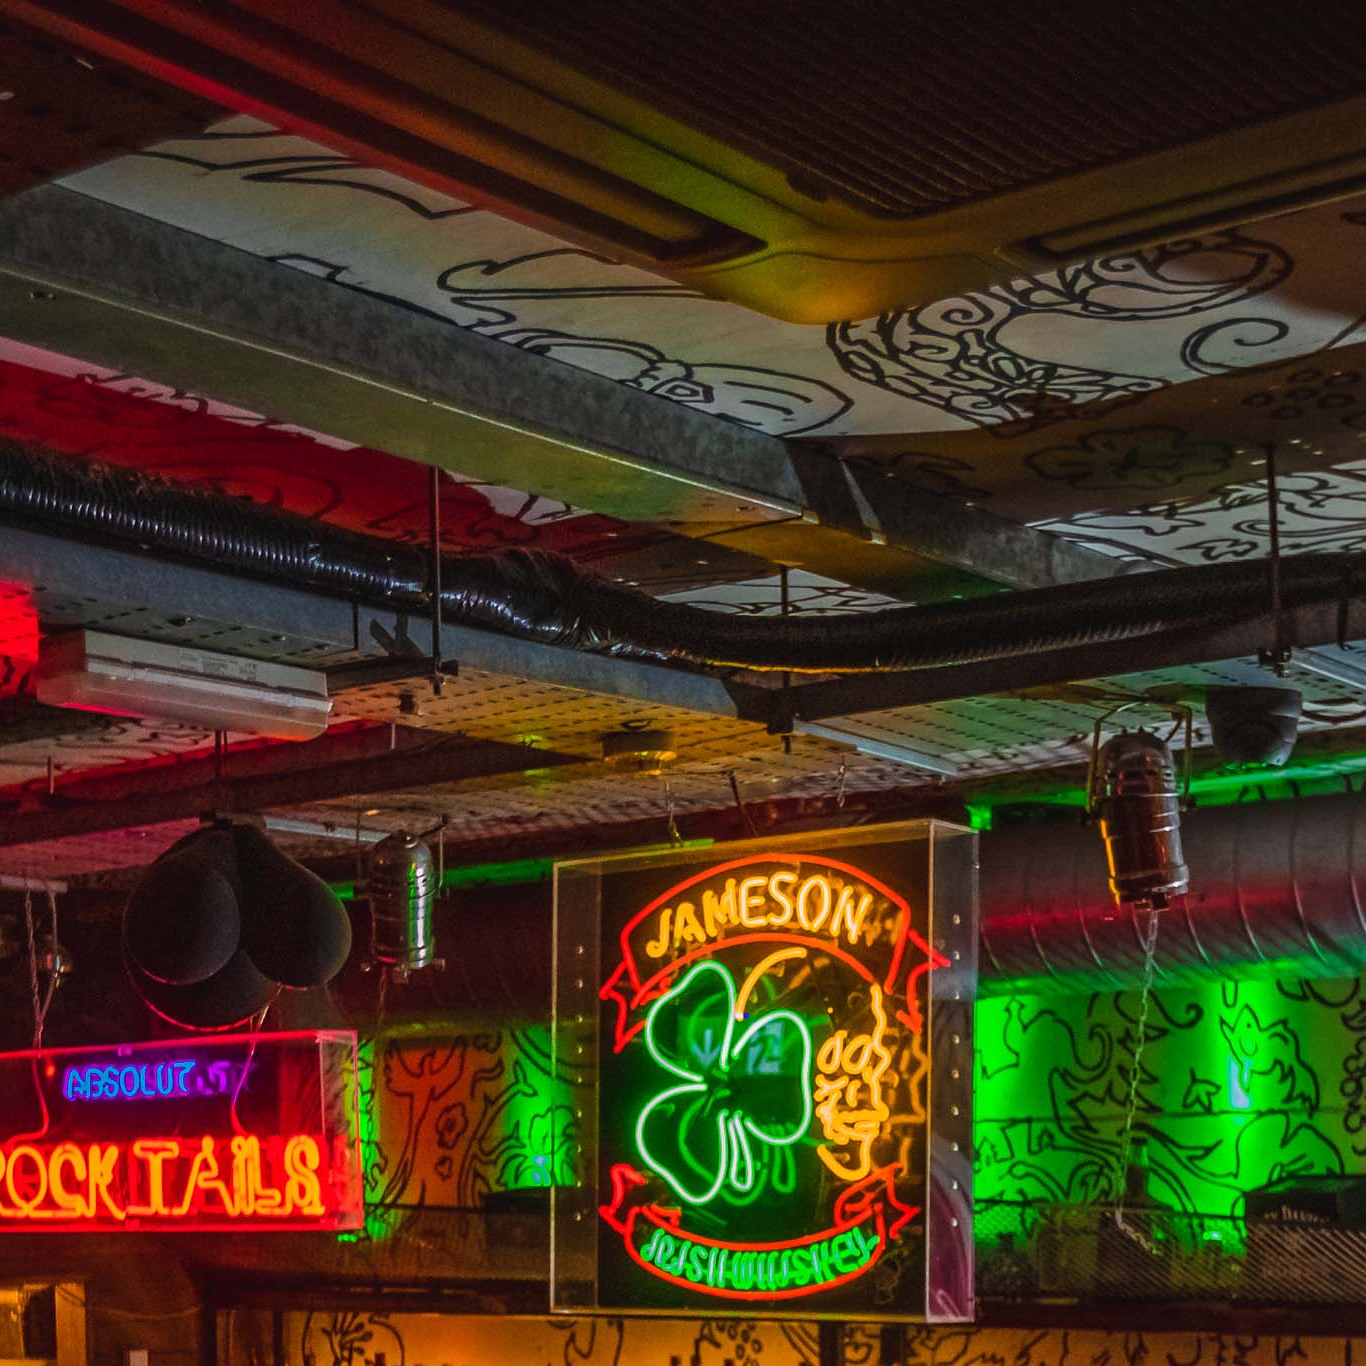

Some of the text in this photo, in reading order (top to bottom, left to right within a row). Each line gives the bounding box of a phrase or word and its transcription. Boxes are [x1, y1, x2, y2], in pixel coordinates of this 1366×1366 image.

[645, 871, 874, 958] JAMESON
[66, 1060, 197, 1101] ABSOLUT
[639, 1227, 729, 1288] IRISH
